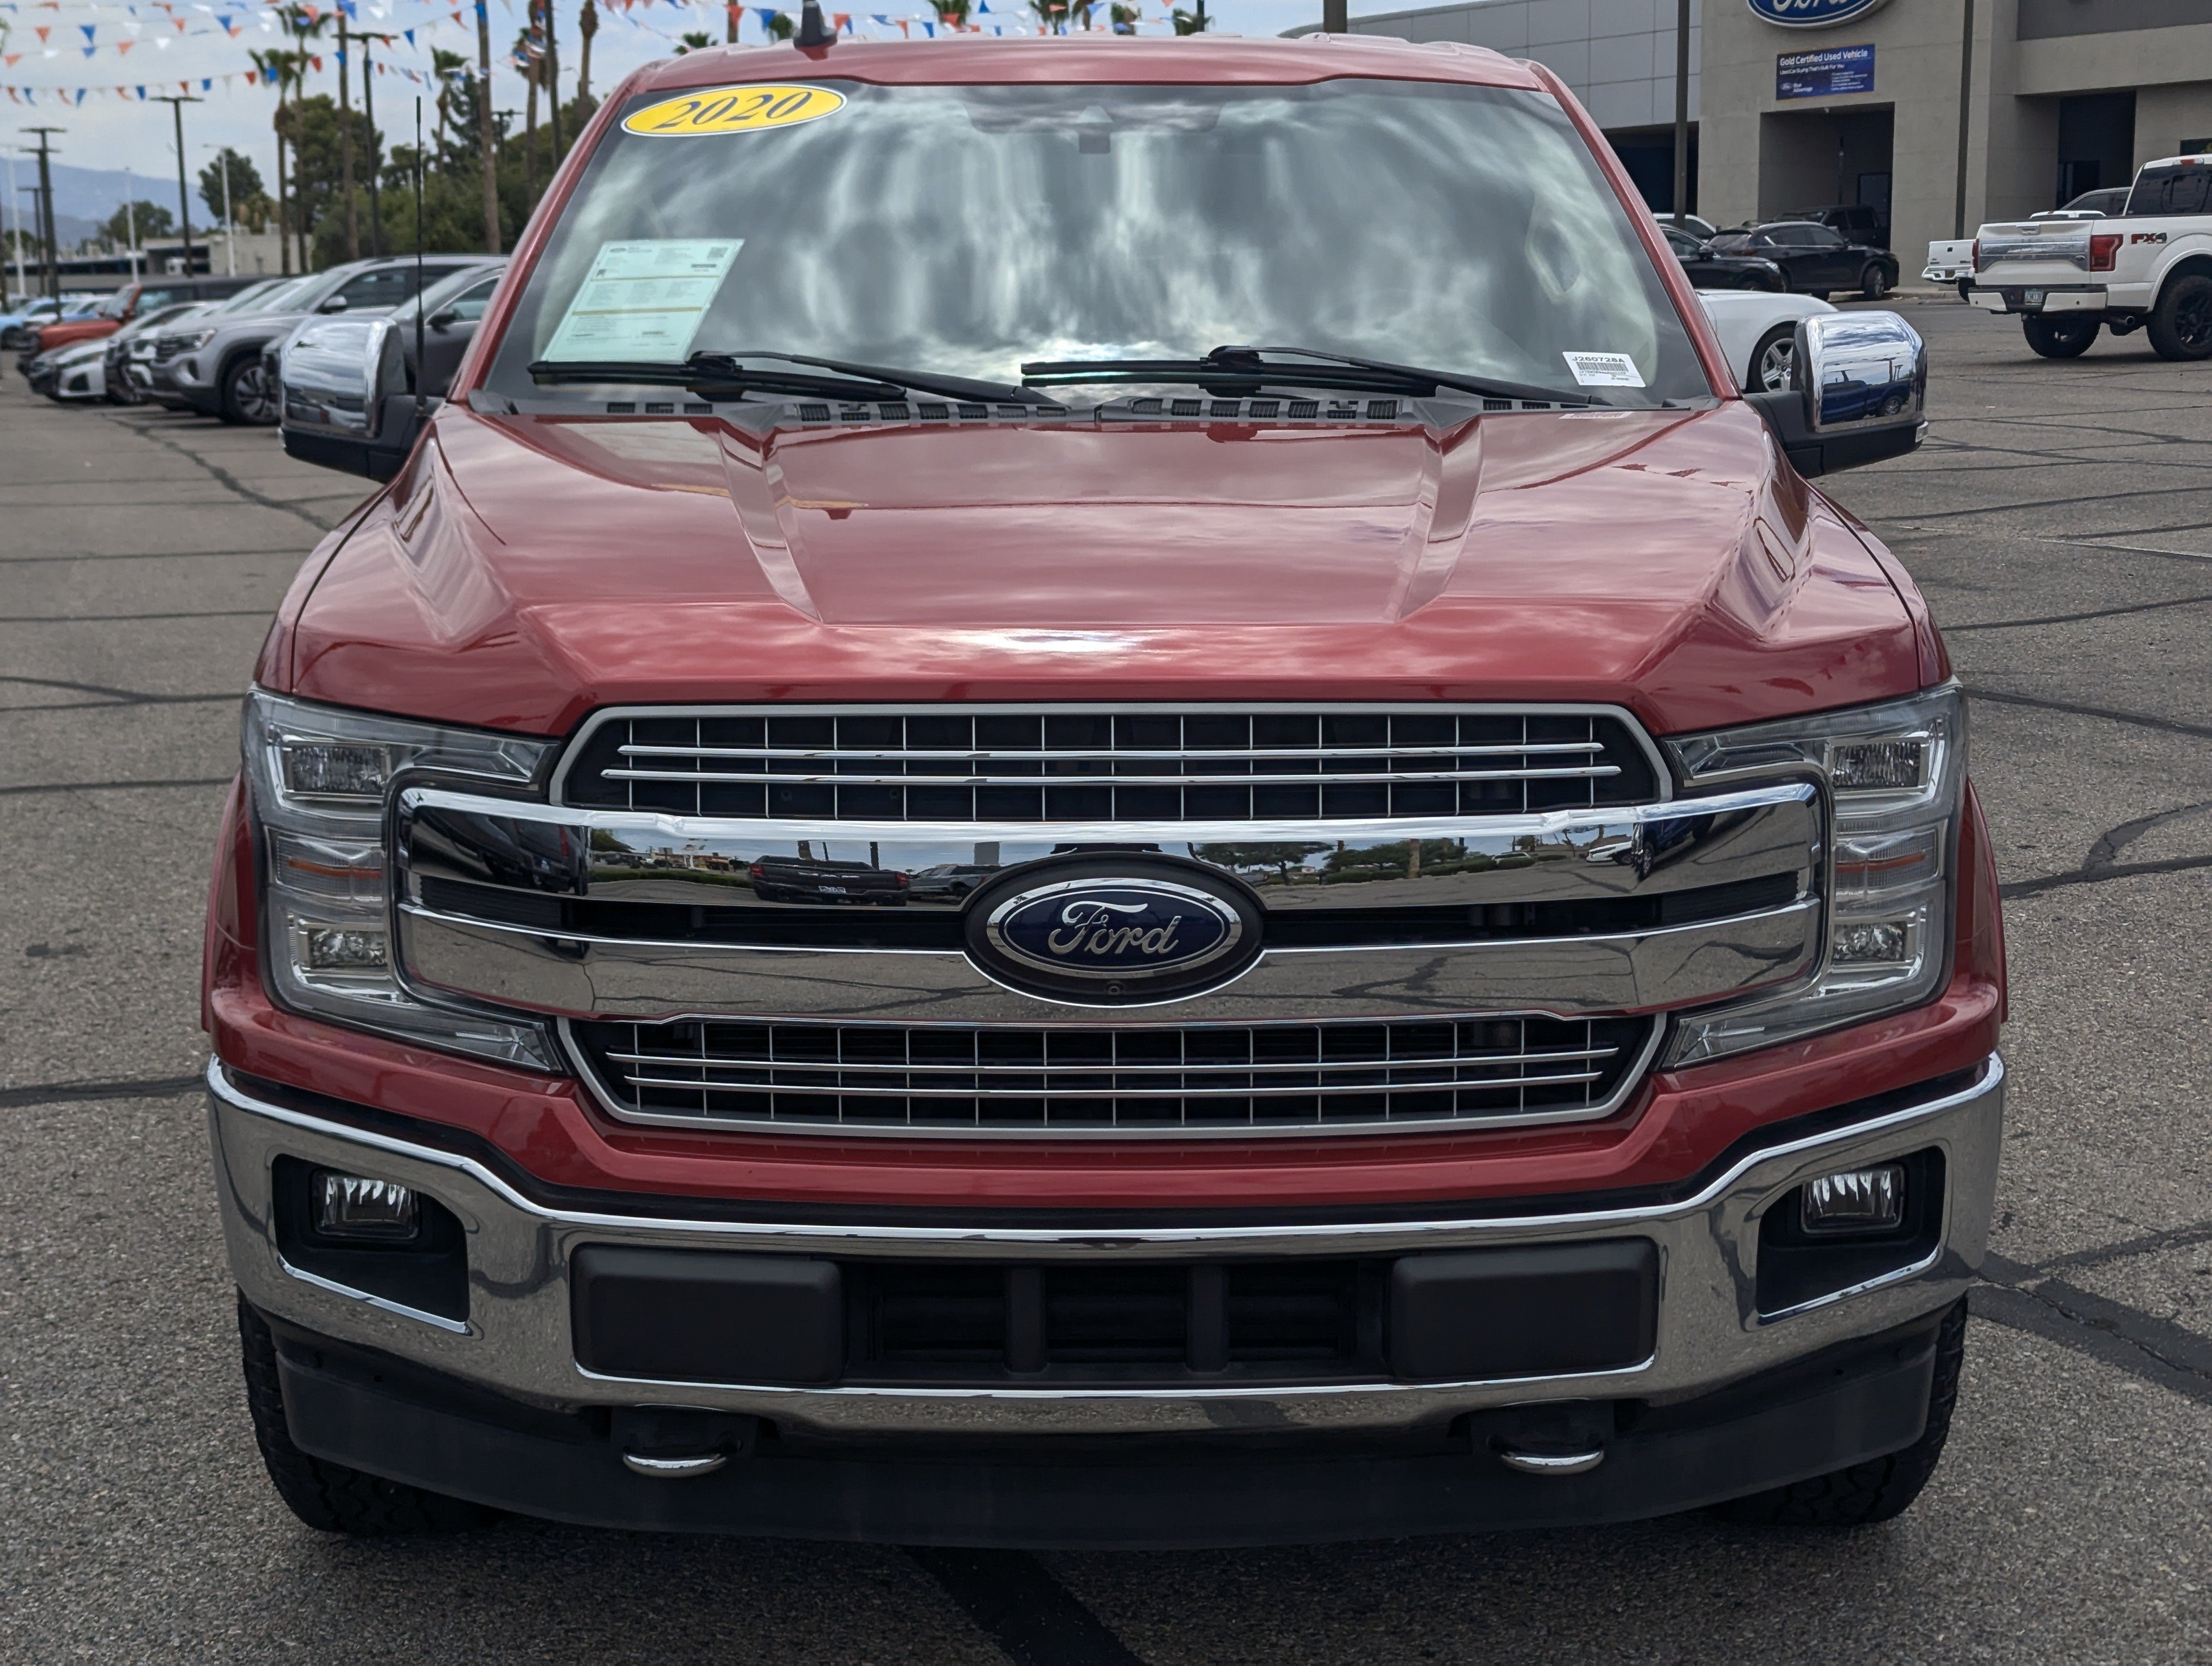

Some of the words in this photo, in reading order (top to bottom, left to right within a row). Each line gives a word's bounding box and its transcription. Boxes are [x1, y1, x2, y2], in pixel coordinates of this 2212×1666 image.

[1780, 56, 1795, 66] Gold
[1796, 53, 1823, 65] Certified
[1824, 52, 1841, 61] Used
[1843, 49, 1868, 59] Vehicle
[651, 92, 812, 130] 2020
[2131, 233, 2167, 244] FX4
[1048, 901, 1182, 955] Ford
